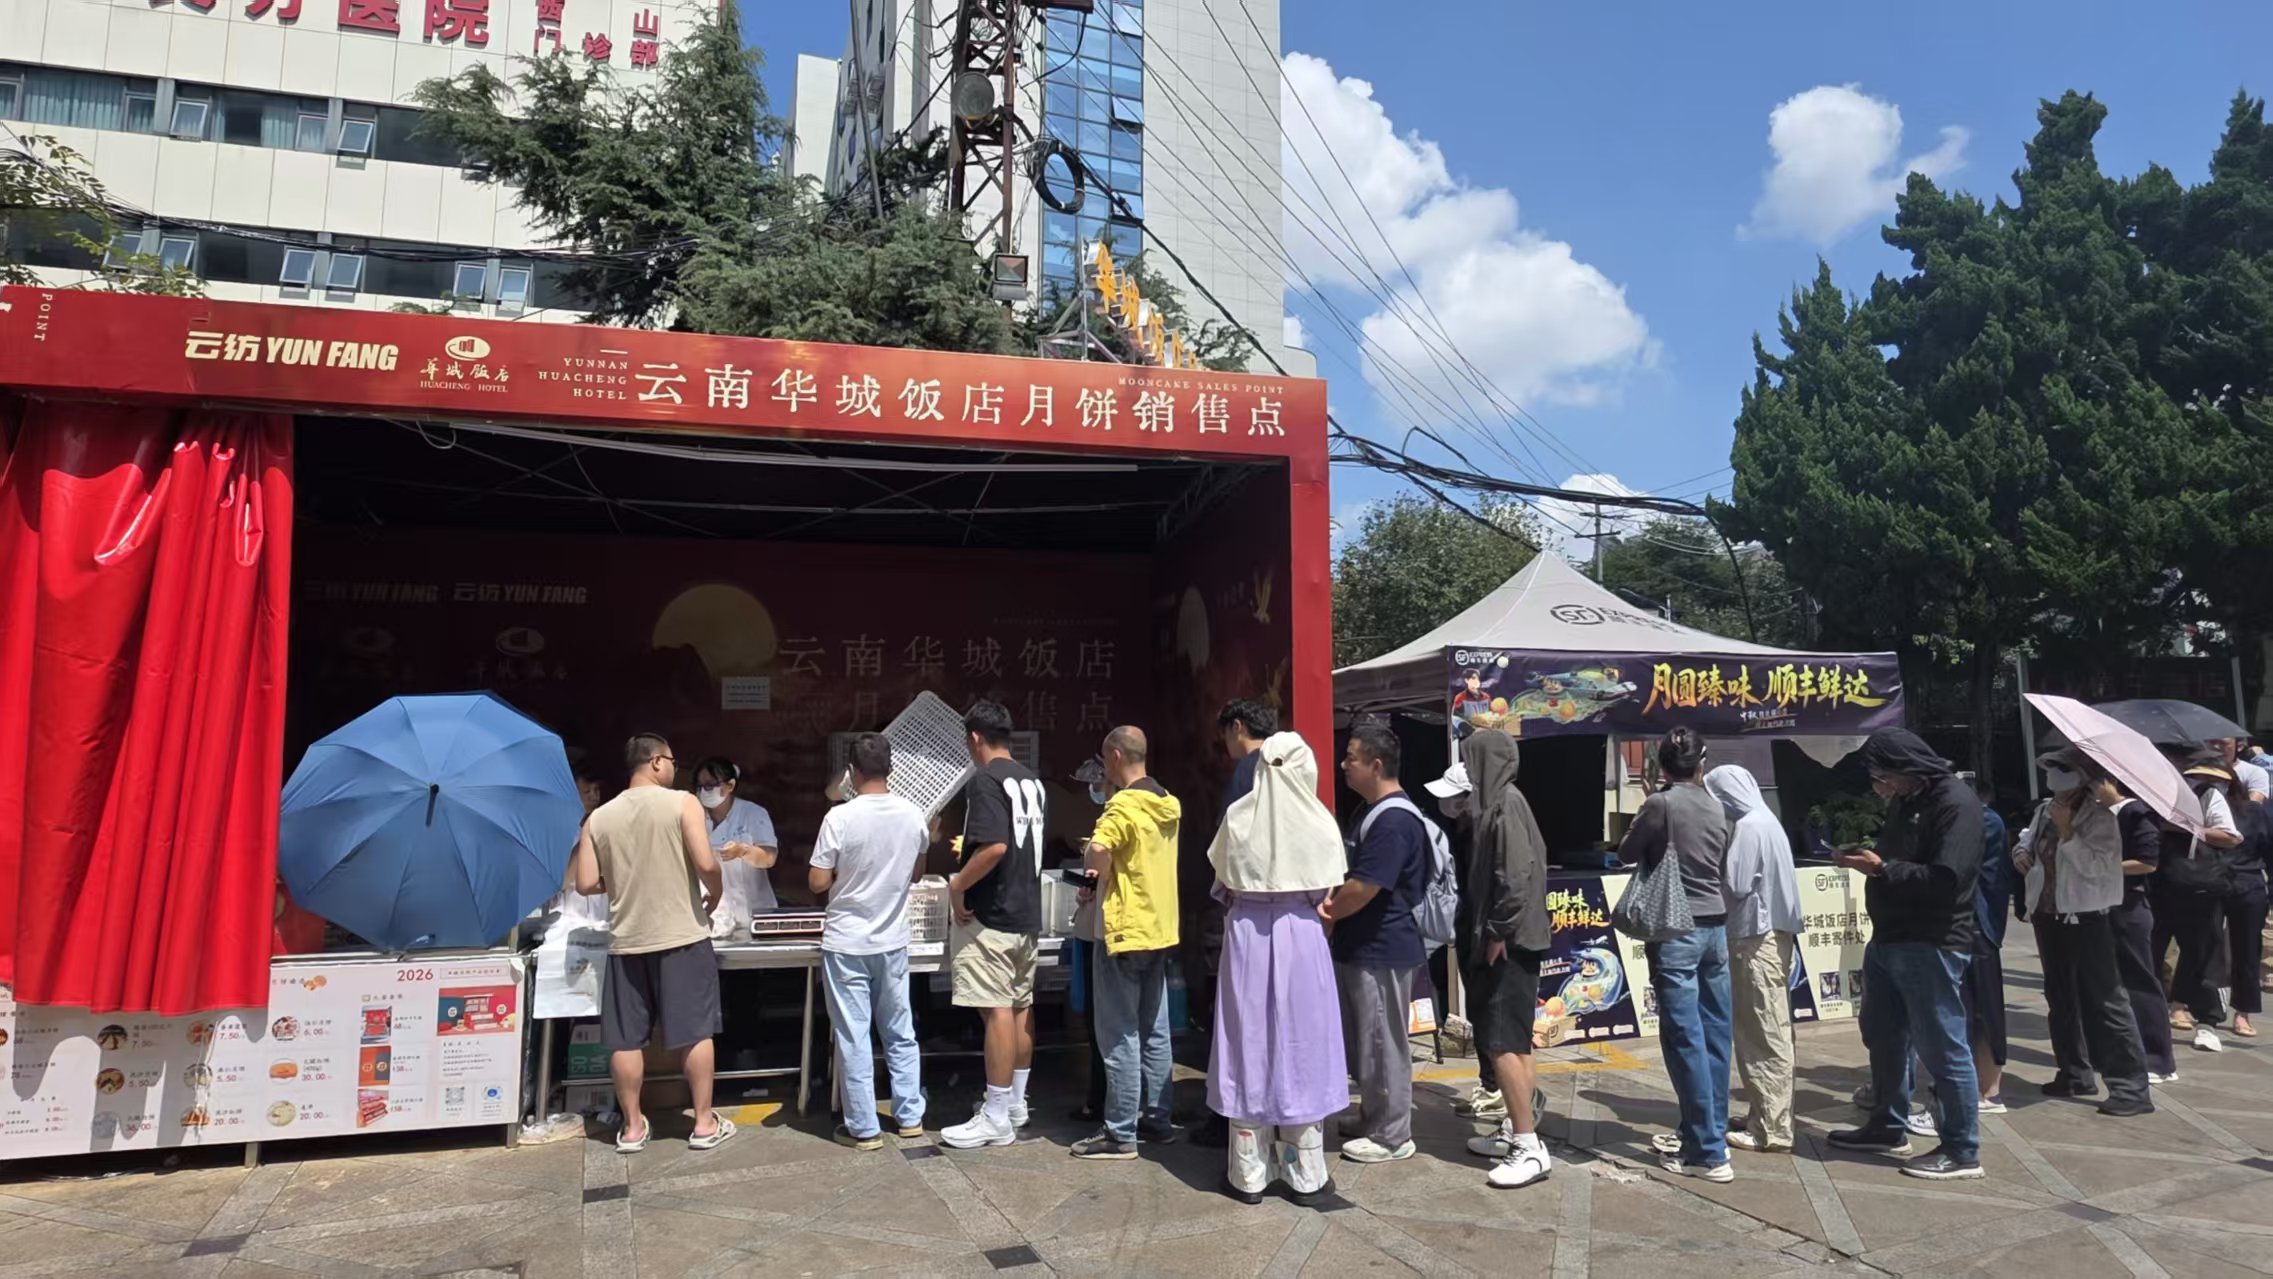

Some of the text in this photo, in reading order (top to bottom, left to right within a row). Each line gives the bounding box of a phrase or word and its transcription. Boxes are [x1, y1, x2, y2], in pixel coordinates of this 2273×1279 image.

[34, 293, 53, 342] POINT
[185, 331, 399, 371] 云纺 YUN FANG
[563, 357, 628, 370] YUNNAN
[420, 380, 508, 393] HUACHENG HOTEL
[538, 371, 627, 385] HUACHENG
[1118, 376, 1284, 395] MOONCAKE SALES POINT
[573, 388, 627, 400] HOTEL
[634, 362, 1286, 437] 云南华城饭店月饼销售点
[778, 633, 1116, 680] 云南华城饭店
[1641, 662, 1889, 716] 月圆臻味 顺丰鲜达
[1808, 929, 1866, 947] 顺丰寄件处
[397, 969, 433, 982] 2026
